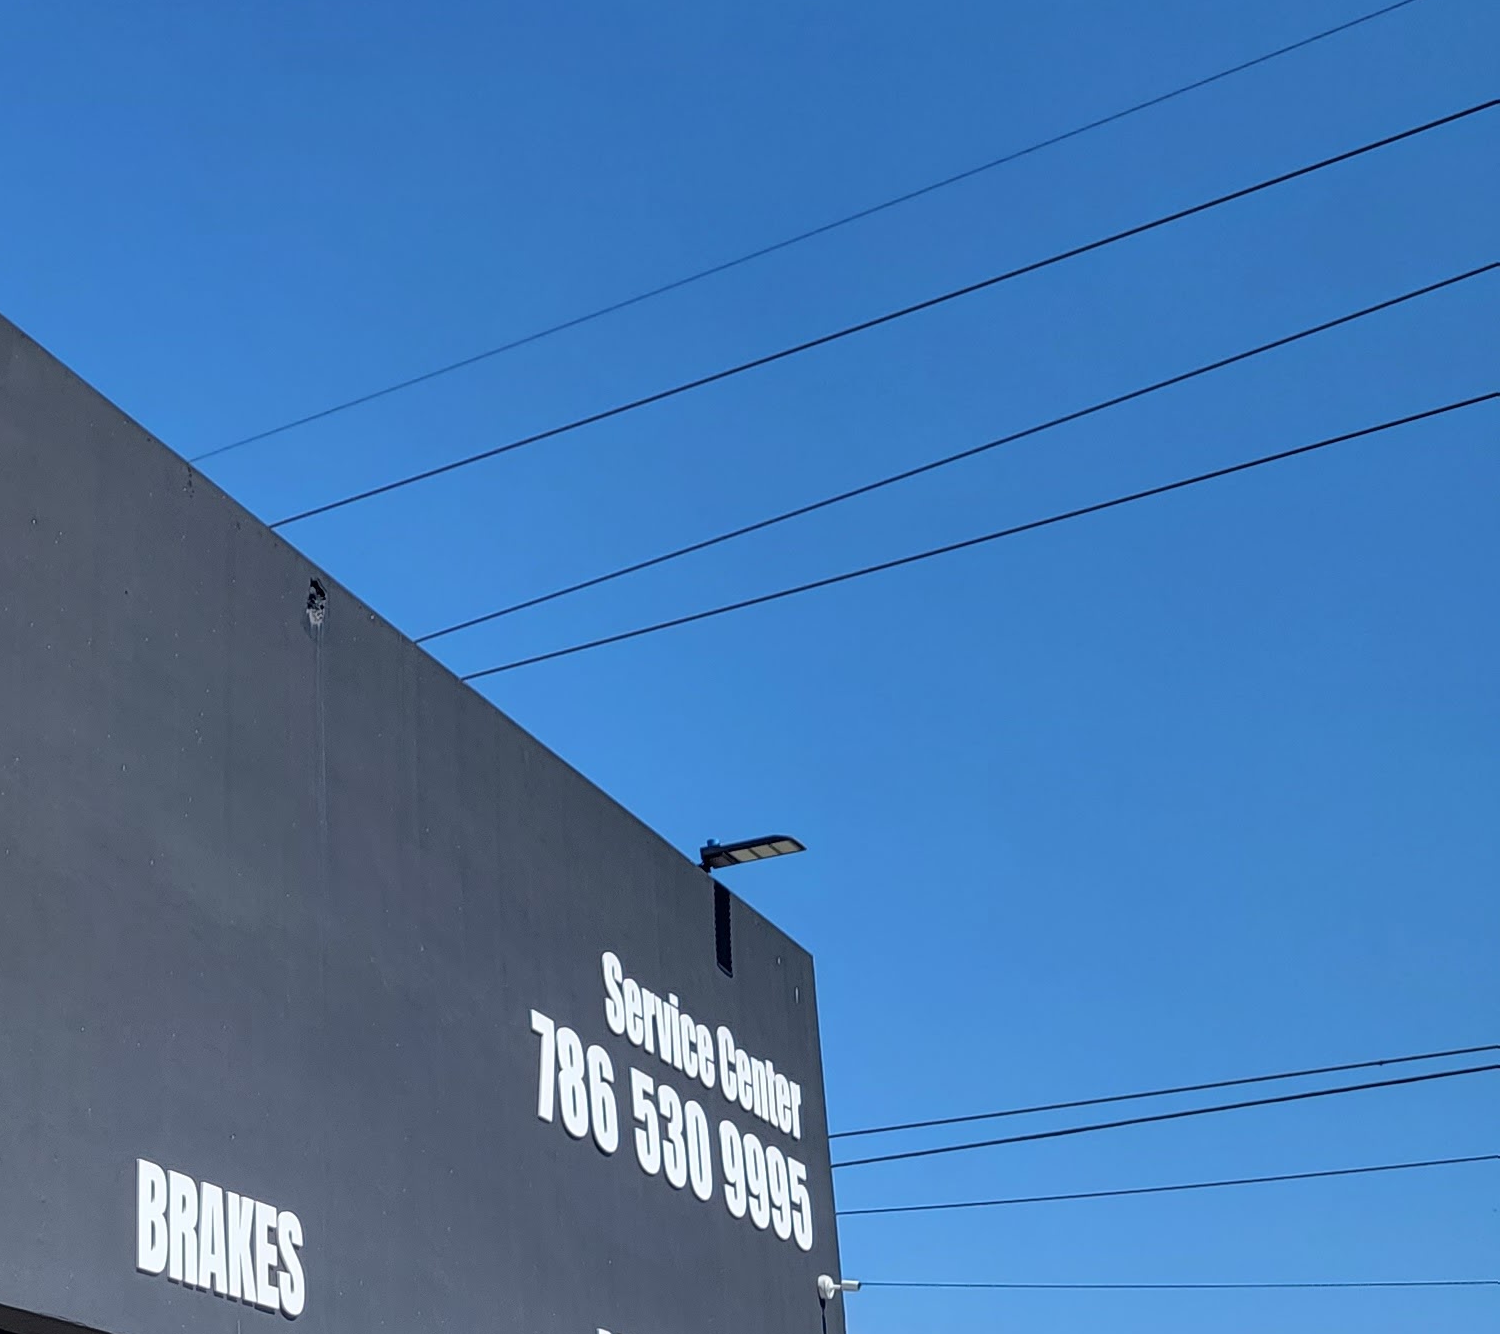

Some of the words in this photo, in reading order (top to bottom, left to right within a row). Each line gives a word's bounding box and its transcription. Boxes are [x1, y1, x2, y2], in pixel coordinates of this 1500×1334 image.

[530, 1009, 619, 1155] 786
[630, 1066, 713, 1202] 530
[719, 1119, 813, 1252] 9995
[602, 951, 716, 1089] Service
[717, 1025, 801, 1140] Center
[136, 1158, 305, 1318] BRAKES
